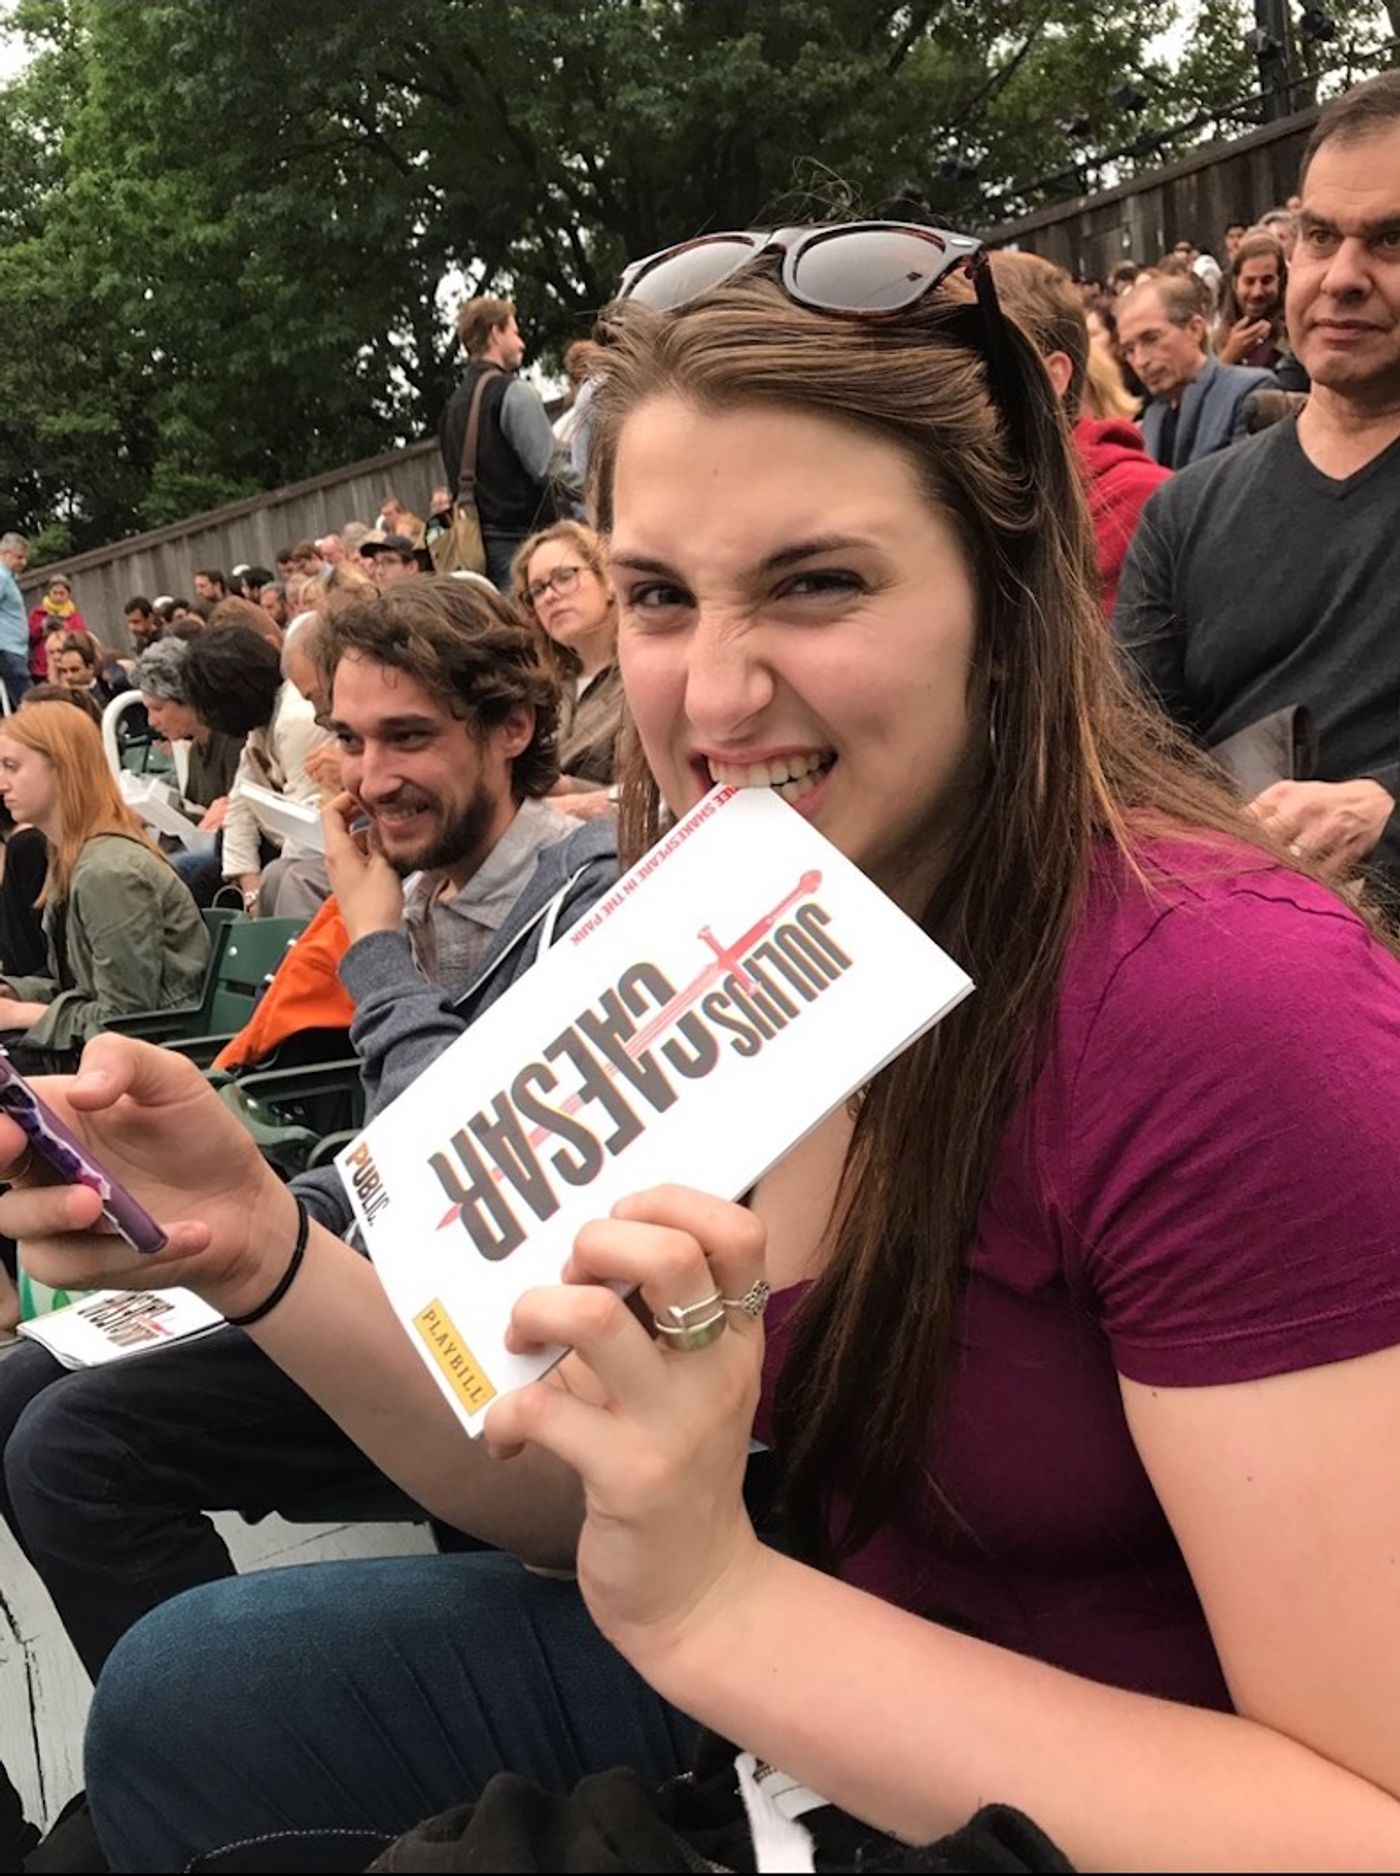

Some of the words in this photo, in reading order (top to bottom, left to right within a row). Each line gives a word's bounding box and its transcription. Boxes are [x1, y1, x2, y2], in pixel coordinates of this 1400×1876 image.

[636, 803, 716, 882] SHAKESPEARE
[602, 892, 625, 918] THE
[623, 878, 638, 895] IN
[570, 913, 602, 946] PARK
[703, 903, 853, 1058] JULIUS
[427, 961, 719, 1261] CAESAR
[422, 1308, 484, 1403] PLAYBILL
